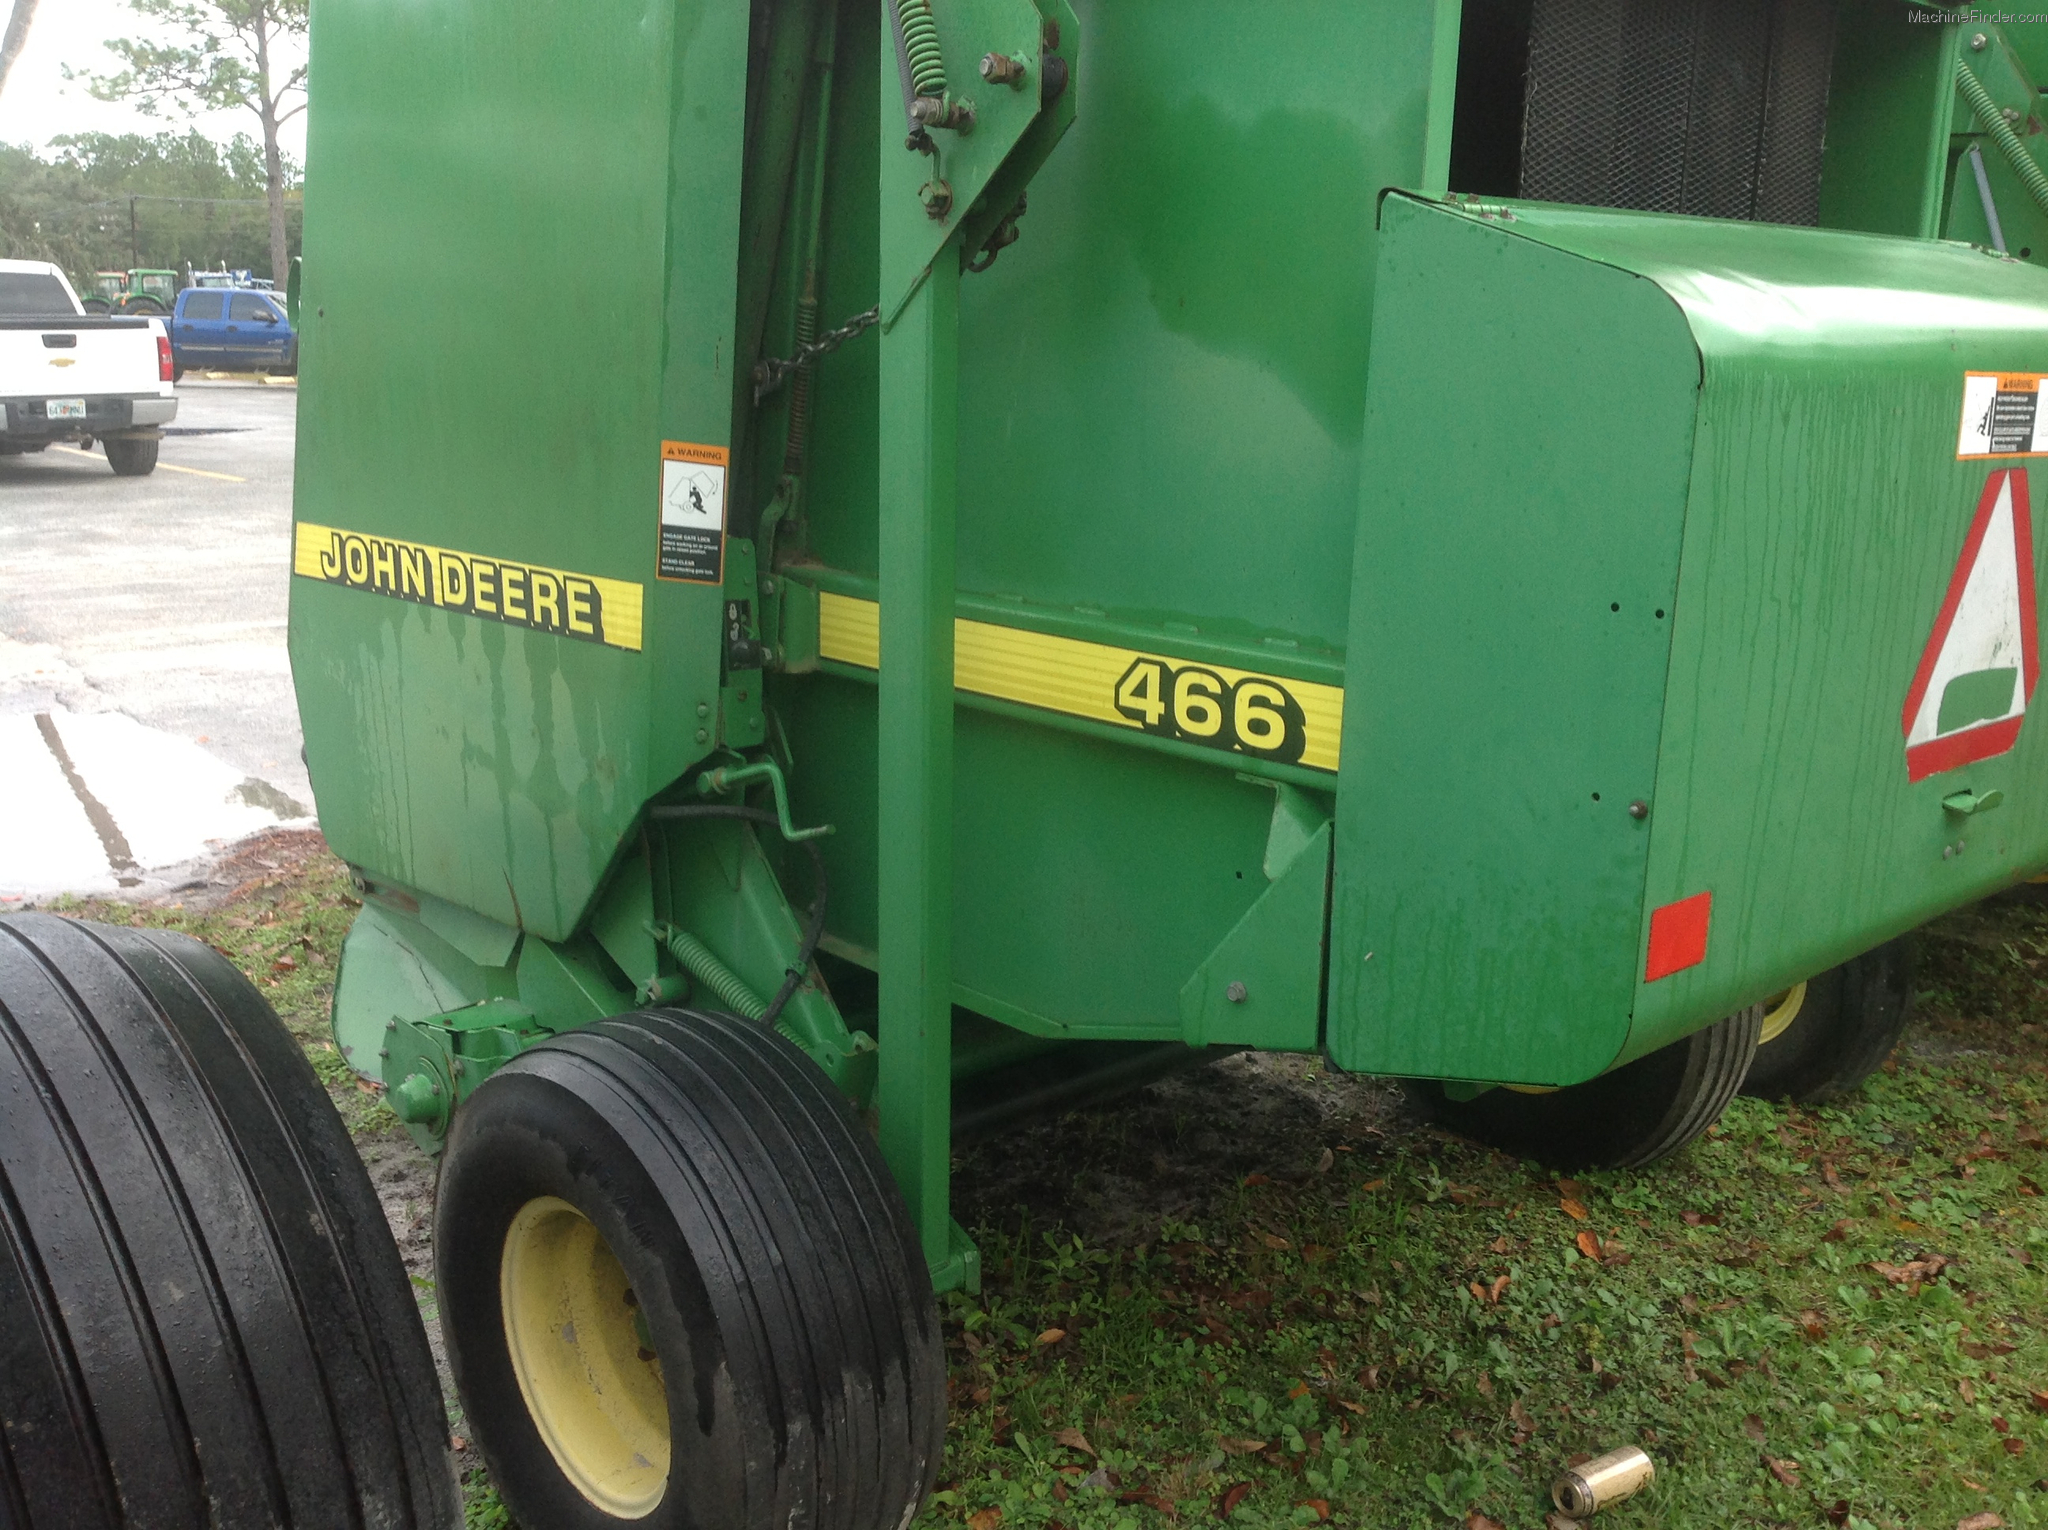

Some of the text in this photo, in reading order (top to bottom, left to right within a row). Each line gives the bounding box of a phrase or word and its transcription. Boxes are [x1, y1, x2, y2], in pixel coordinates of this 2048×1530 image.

[677, 447, 722, 460] WARNING
[320, 531, 603, 640] JOHN DEERE
[1114, 656, 1306, 758] 466
